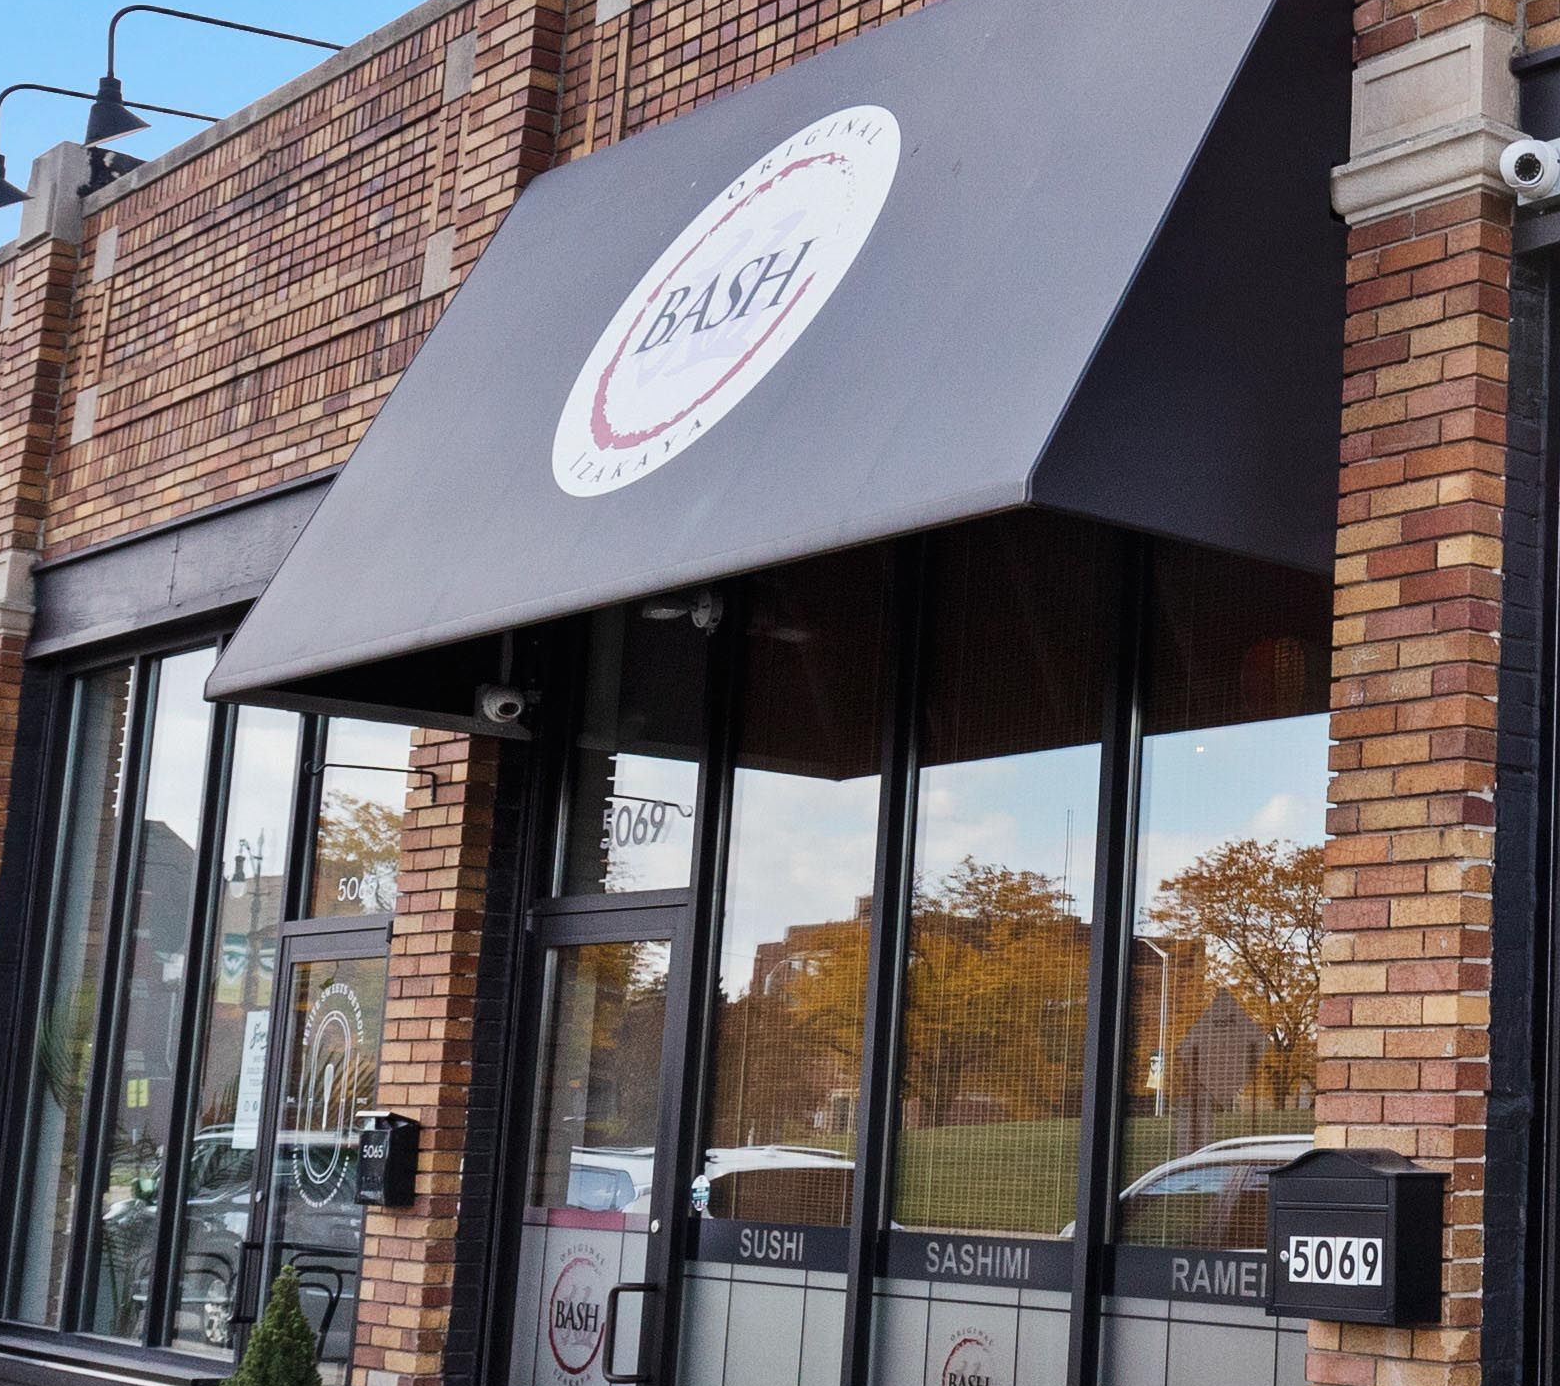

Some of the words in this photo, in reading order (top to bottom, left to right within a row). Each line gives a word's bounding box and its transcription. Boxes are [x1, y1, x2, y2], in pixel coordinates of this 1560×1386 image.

[727, 117, 884, 199] ORIGINAL
[631, 237, 819, 357] BASH
[568, 418, 703, 484] IZAKAYA
[600, 800, 666, 849] 5069
[321, 982, 348, 1002] SWEETS
[347, 990, 364, 1046] DETROIT
[362, 1144, 384, 1160] 5065
[740, 1227, 805, 1262] SUSHI
[925, 1241, 1032, 1281] SASHIMI
[1291, 1239, 1380, 1282] 5069
[554, 1300, 601, 1333] BASH
